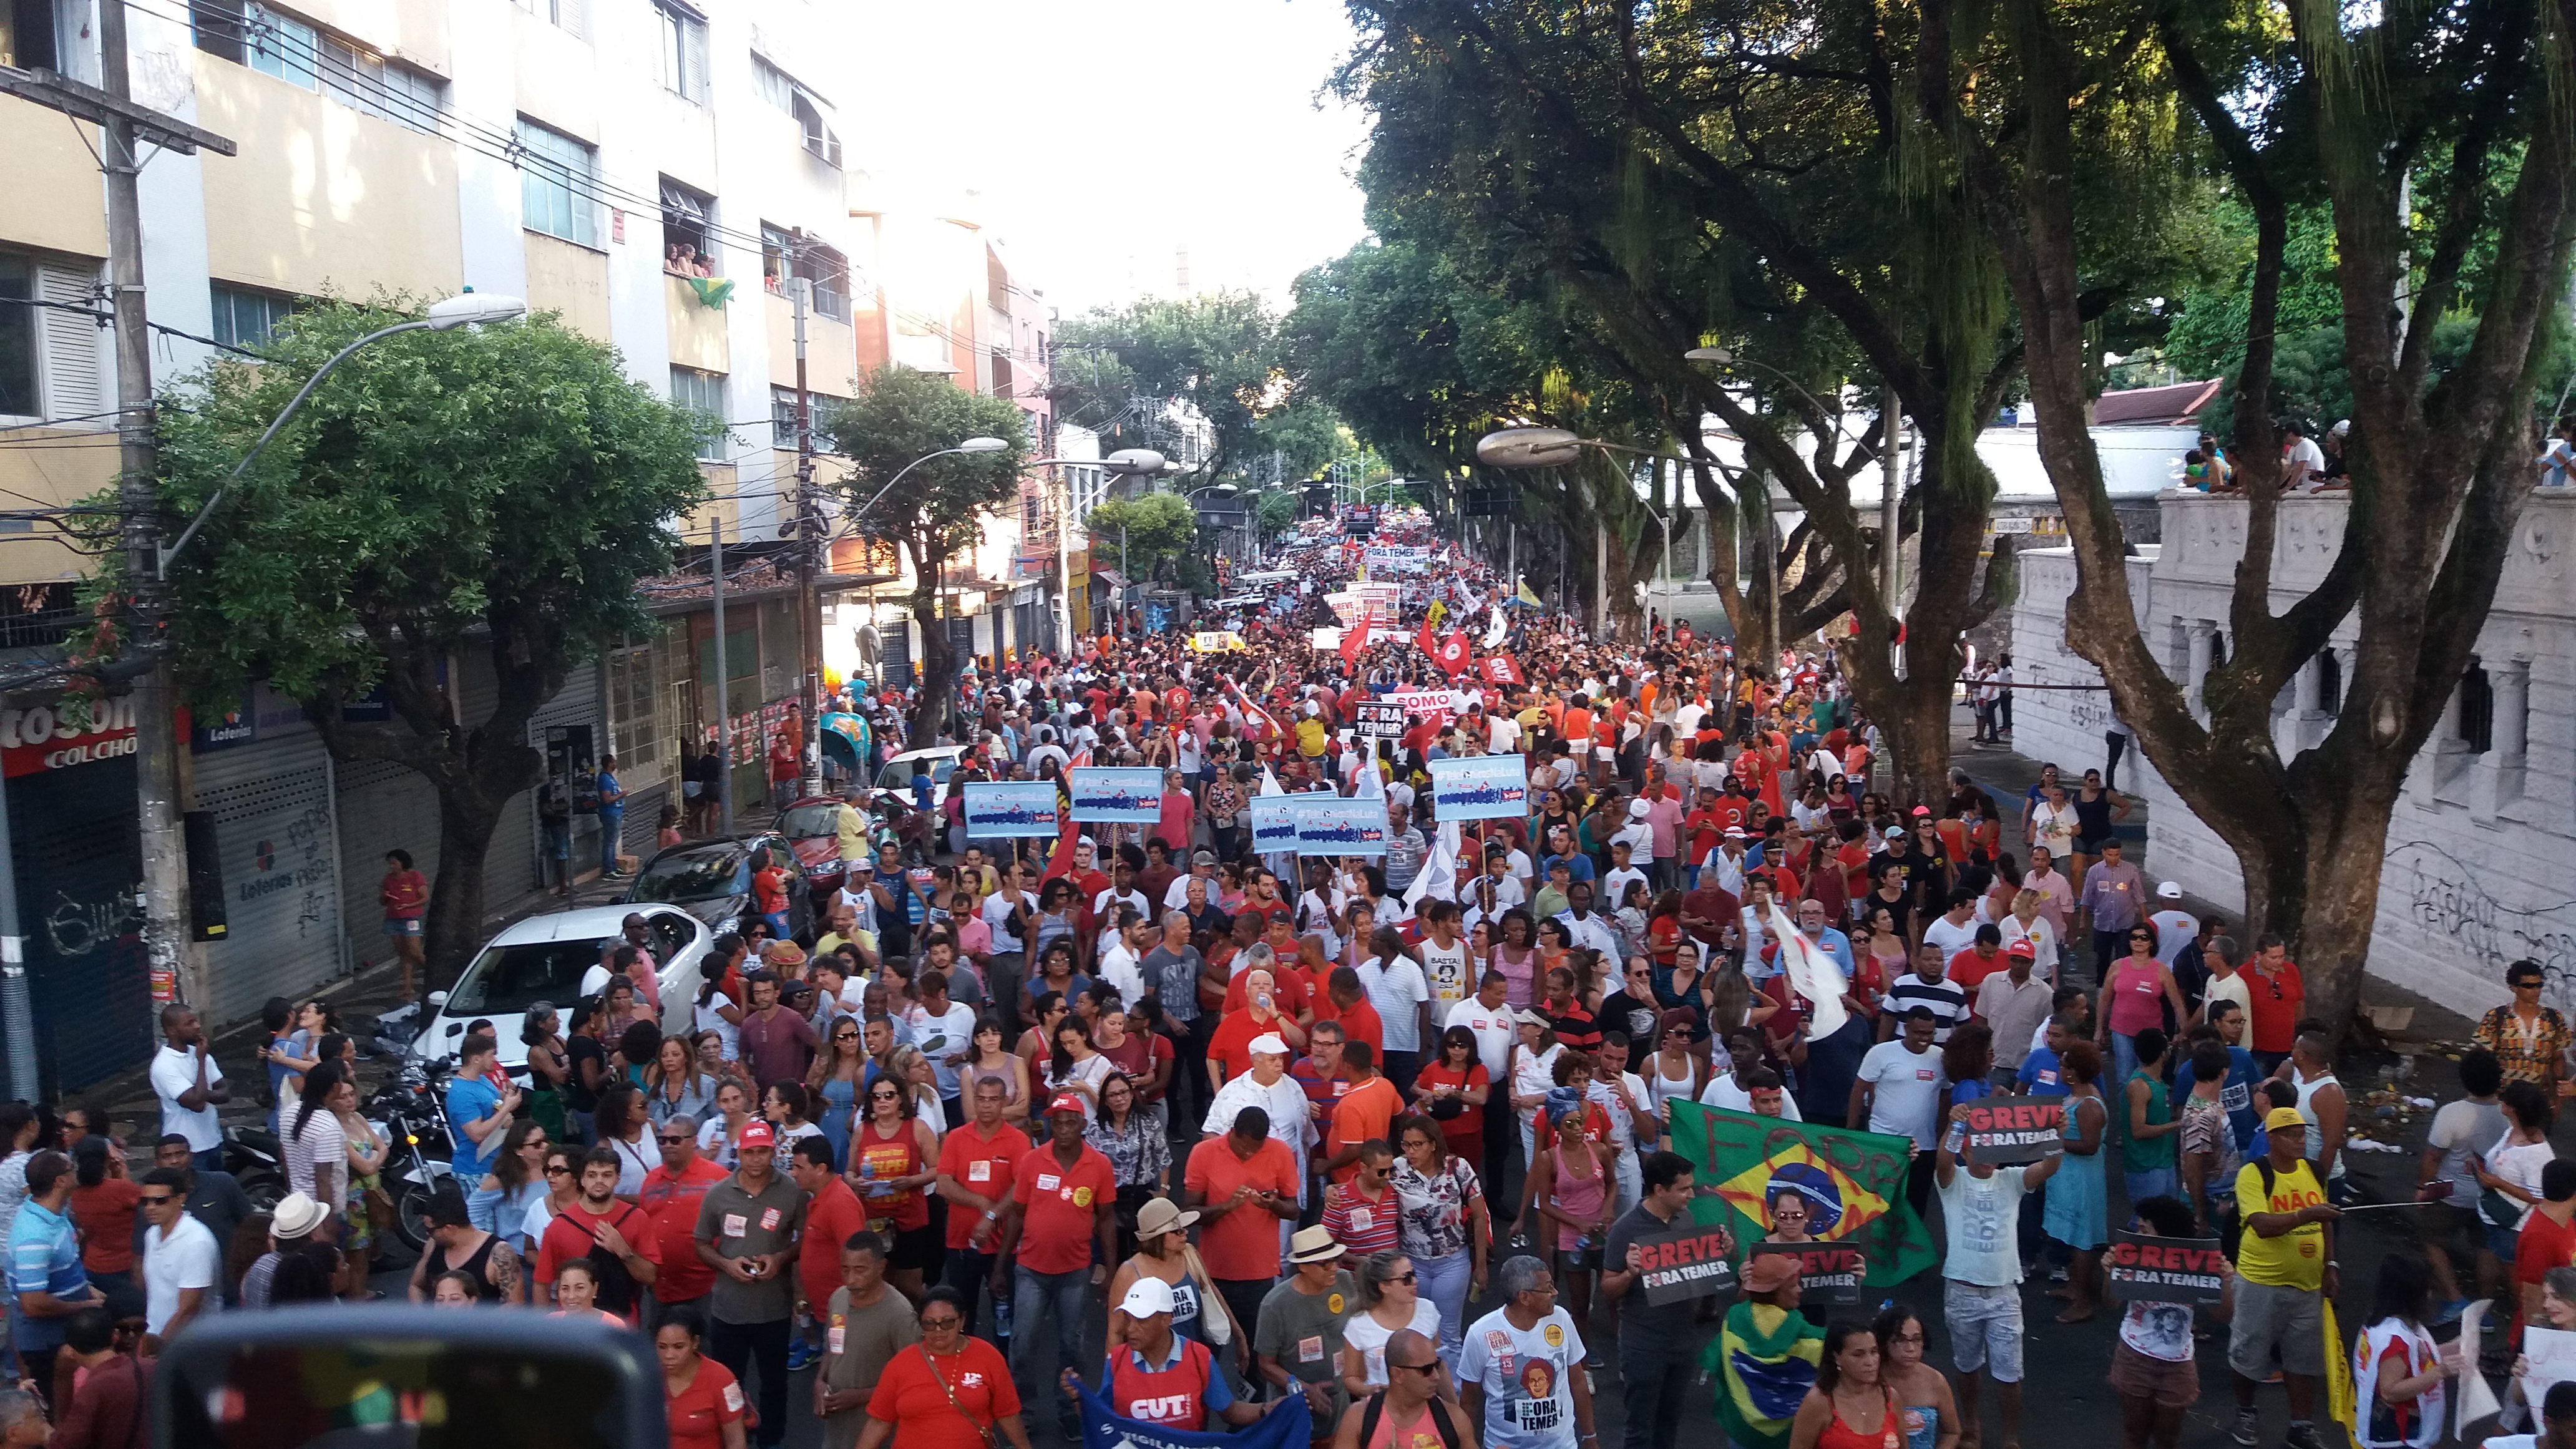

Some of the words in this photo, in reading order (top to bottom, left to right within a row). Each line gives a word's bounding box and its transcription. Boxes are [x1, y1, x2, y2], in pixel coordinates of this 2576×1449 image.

[1389, 549, 1415, 557] TEMER
[1357, 706, 1403, 721] FORA
[210, 724, 252, 742] Loterias
[1357, 721, 1403, 735] TEMER
[240, 874, 293, 901] Loterias
[2017, 1128, 2059, 1144] TEMER
[2271, 1189, 2320, 1212] NÃO
[1641, 1234, 1723, 1271] GREVE
[2115, 1242, 2222, 1273] GREVE
[1642, 1269, 1682, 1289] FORA
[1680, 1261, 1730, 1281] TEMER
[1801, 1274, 1856, 1289] TEMER
[2161, 1272, 2222, 1290] TEMER
[1130, 1394, 1186, 1420] CUT
[1521, 1413, 1558, 1431] TEMER
